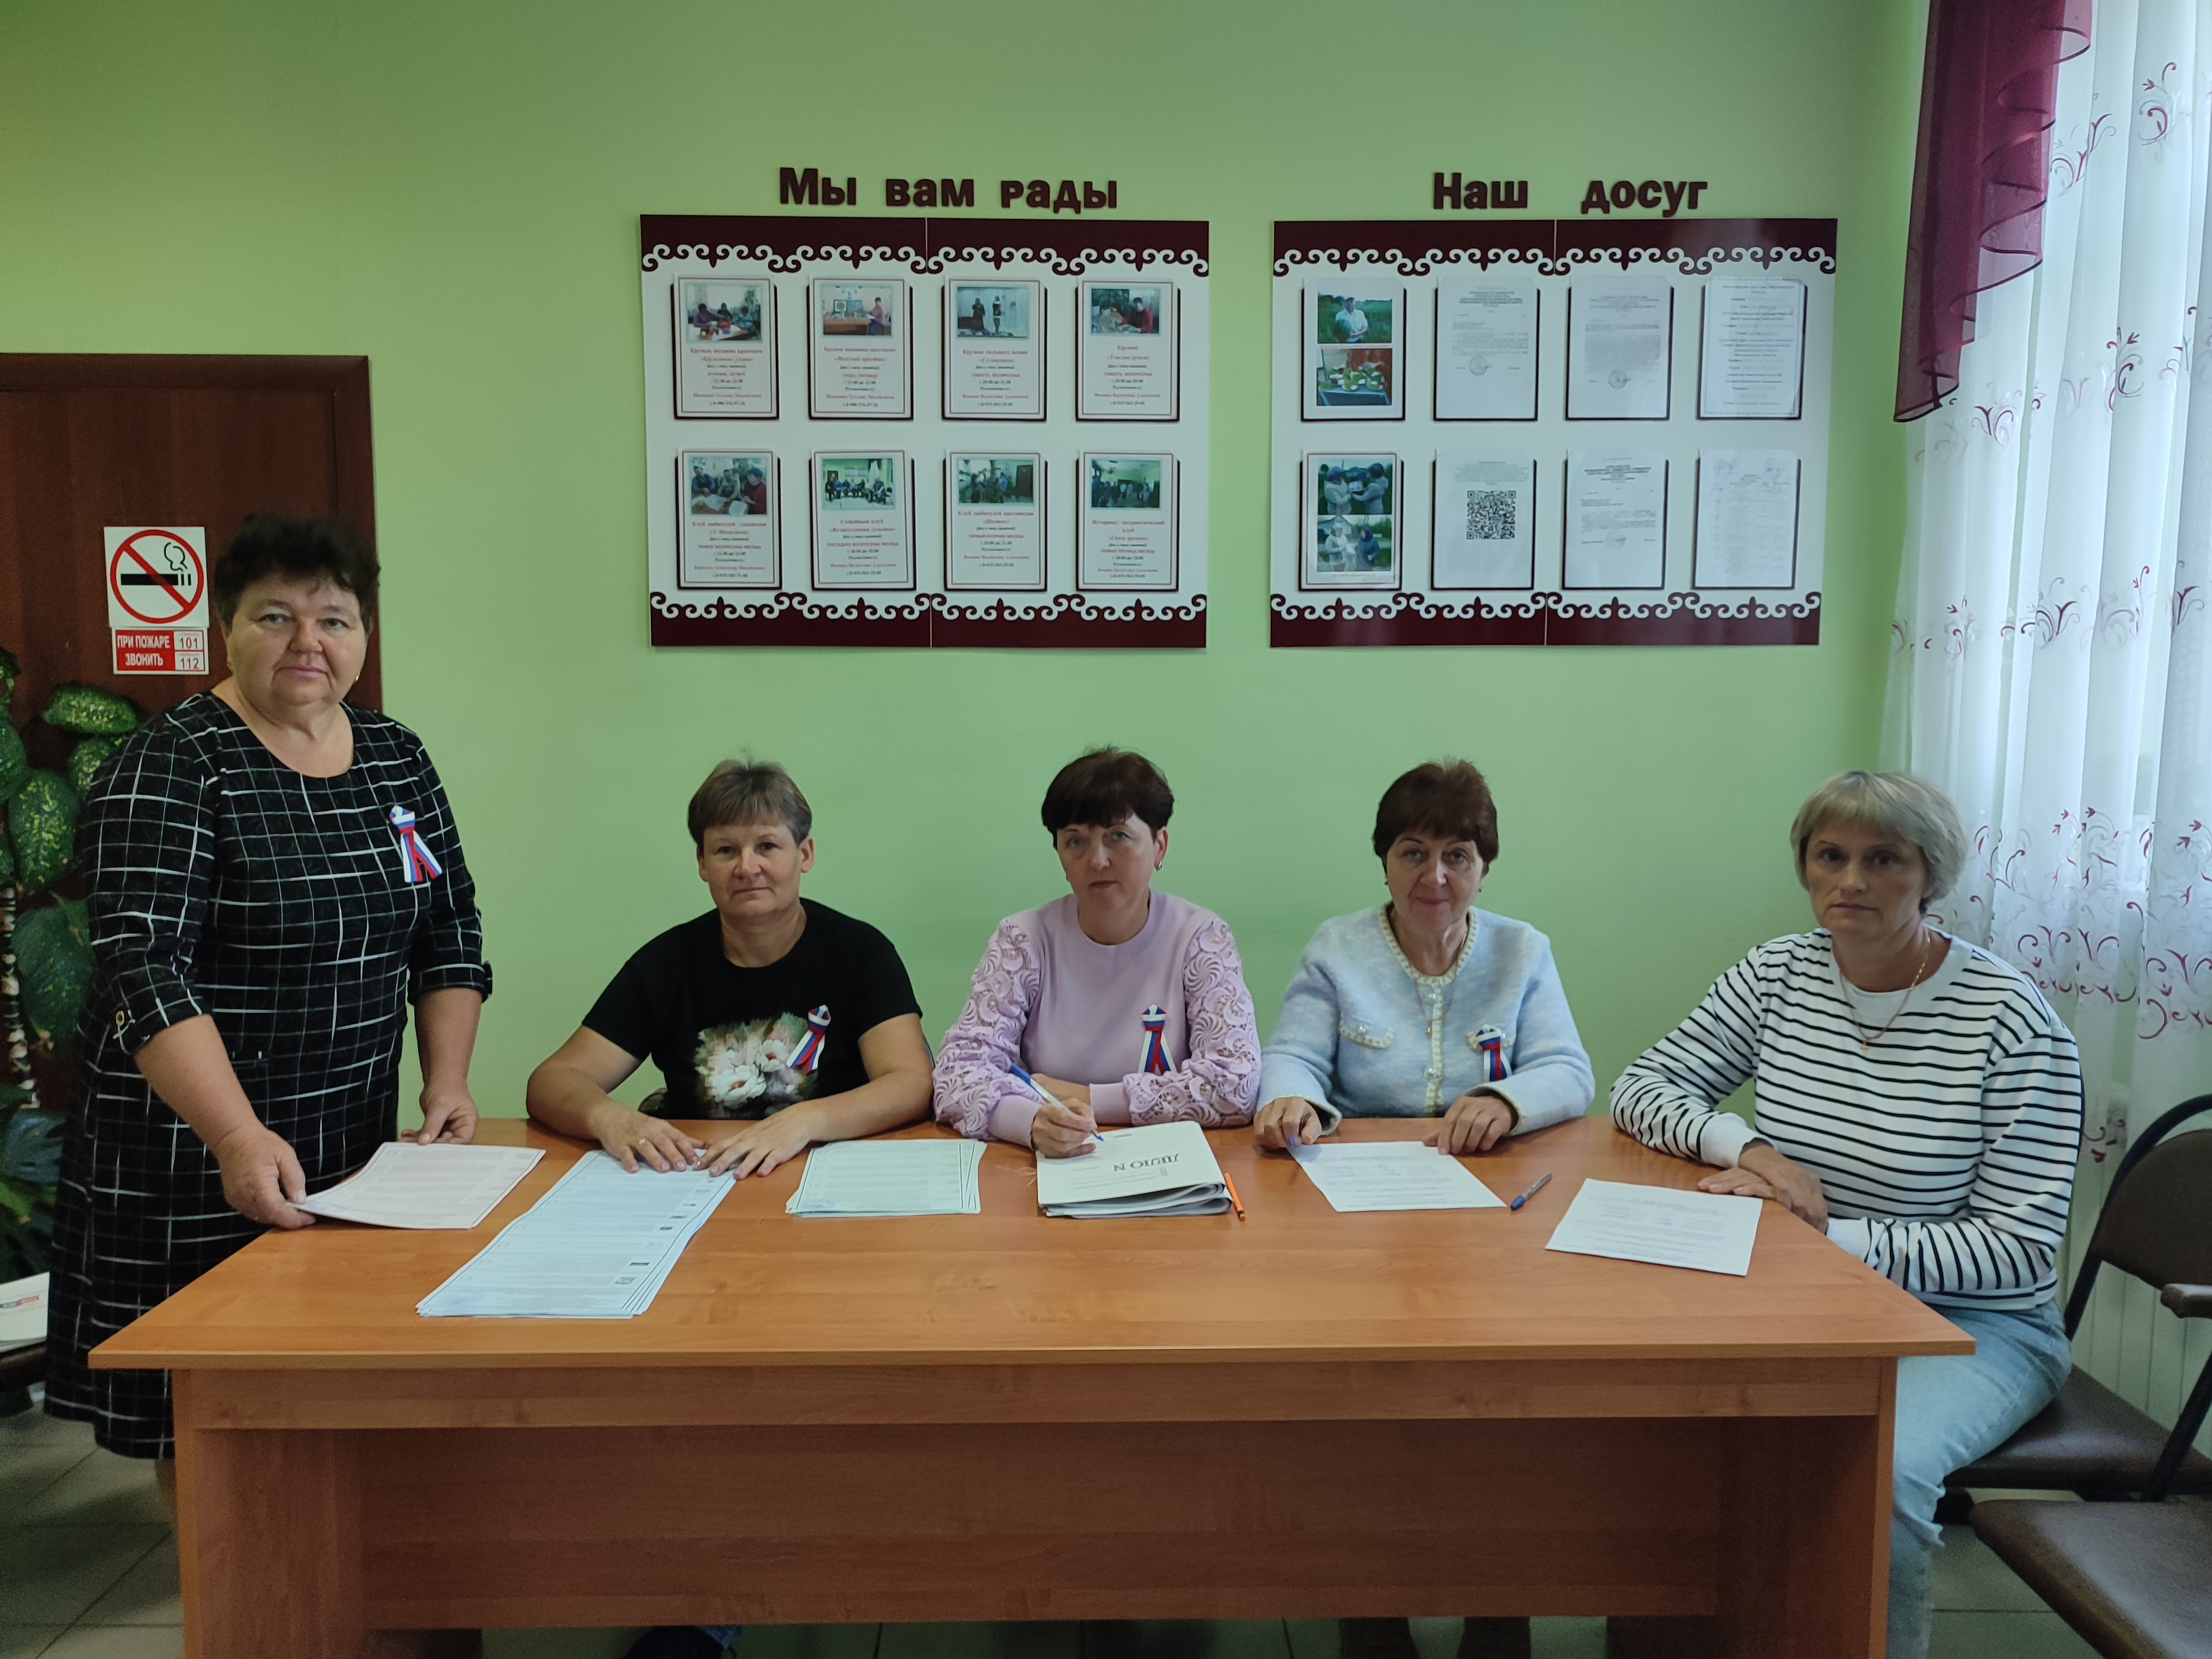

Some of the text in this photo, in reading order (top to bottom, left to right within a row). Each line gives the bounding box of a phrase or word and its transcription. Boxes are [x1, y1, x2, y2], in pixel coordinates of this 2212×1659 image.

[780, 167, 1117, 214] Мы вам рады
[1433, 173, 1708, 218] Наш досуг
[117, 635, 170, 649] ПРИ ПОЖАРЕ
[179, 637, 199, 649] 101
[125, 653, 164, 666] ЗВОНИТЬ
[180, 658, 199, 670] 112
